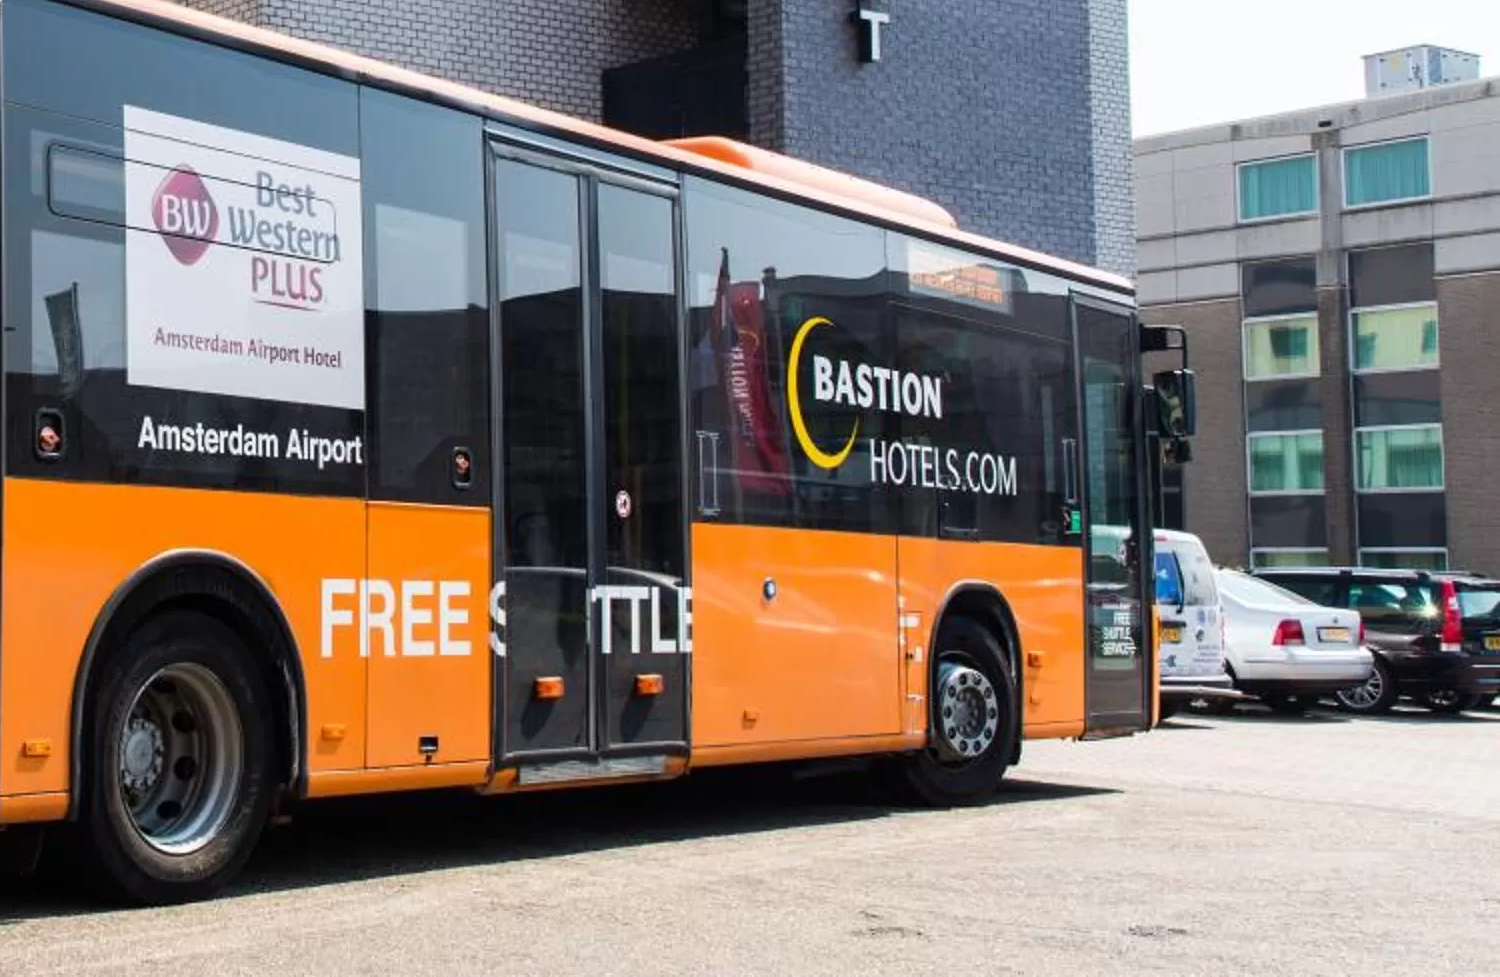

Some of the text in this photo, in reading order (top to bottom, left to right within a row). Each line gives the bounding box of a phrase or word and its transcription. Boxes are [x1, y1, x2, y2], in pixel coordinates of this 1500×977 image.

[256, 170, 317, 218] Best
[161, 194, 342, 263] BW Western
[250, 256, 324, 303] PLUS
[153, 326, 343, 368] Amsterdam Airport Hotel
[813, 354, 943, 419] BASTION
[138, 416, 364, 470] Amsterdam Airport
[870, 438, 1018, 496] HOTELS.COM
[321, 578, 693, 658] FREE STTLE
